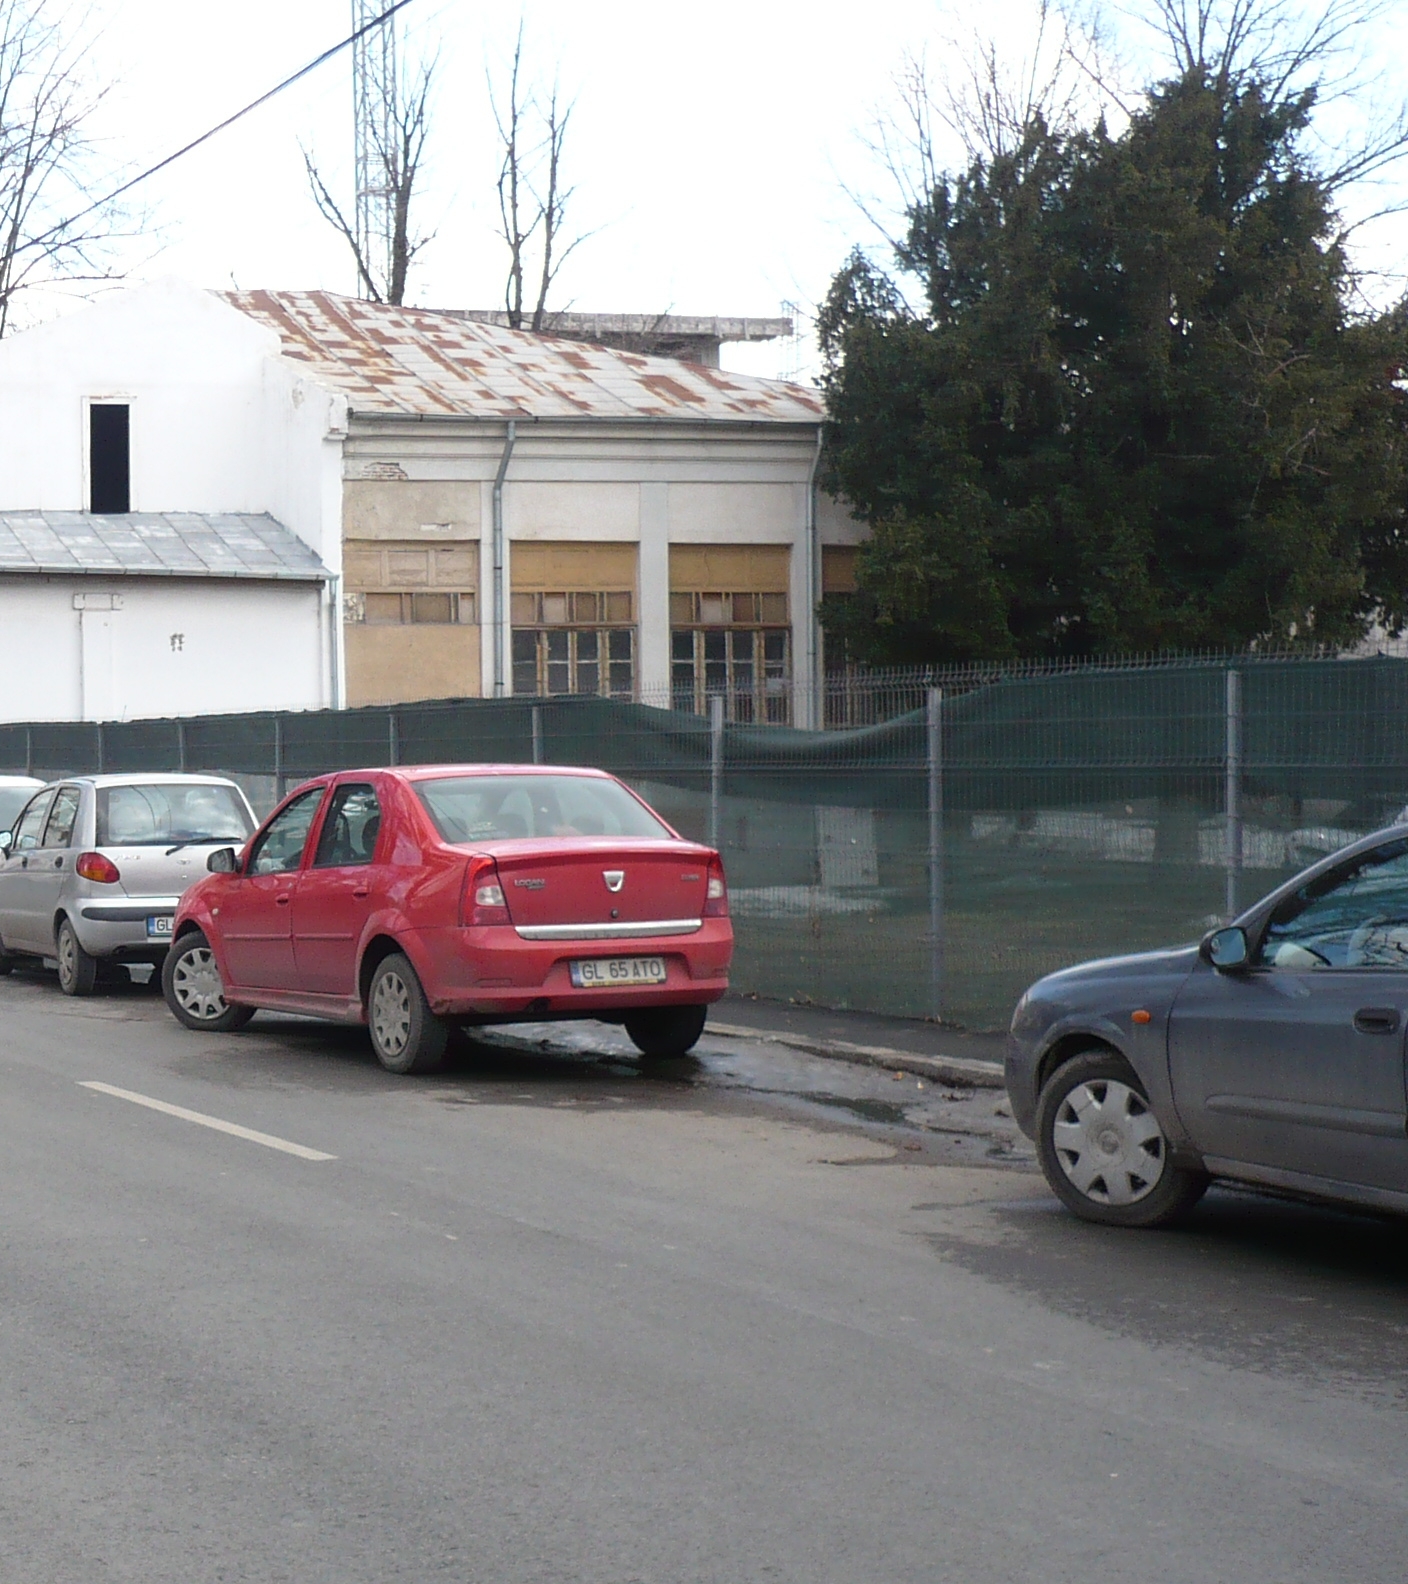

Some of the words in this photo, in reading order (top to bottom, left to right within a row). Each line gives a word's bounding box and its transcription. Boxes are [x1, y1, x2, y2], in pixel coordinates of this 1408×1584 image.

[156, 918, 174, 932] GL
[582, 963, 604, 980] GL
[609, 961, 628, 978] 65
[632, 960, 661, 978] ATO
